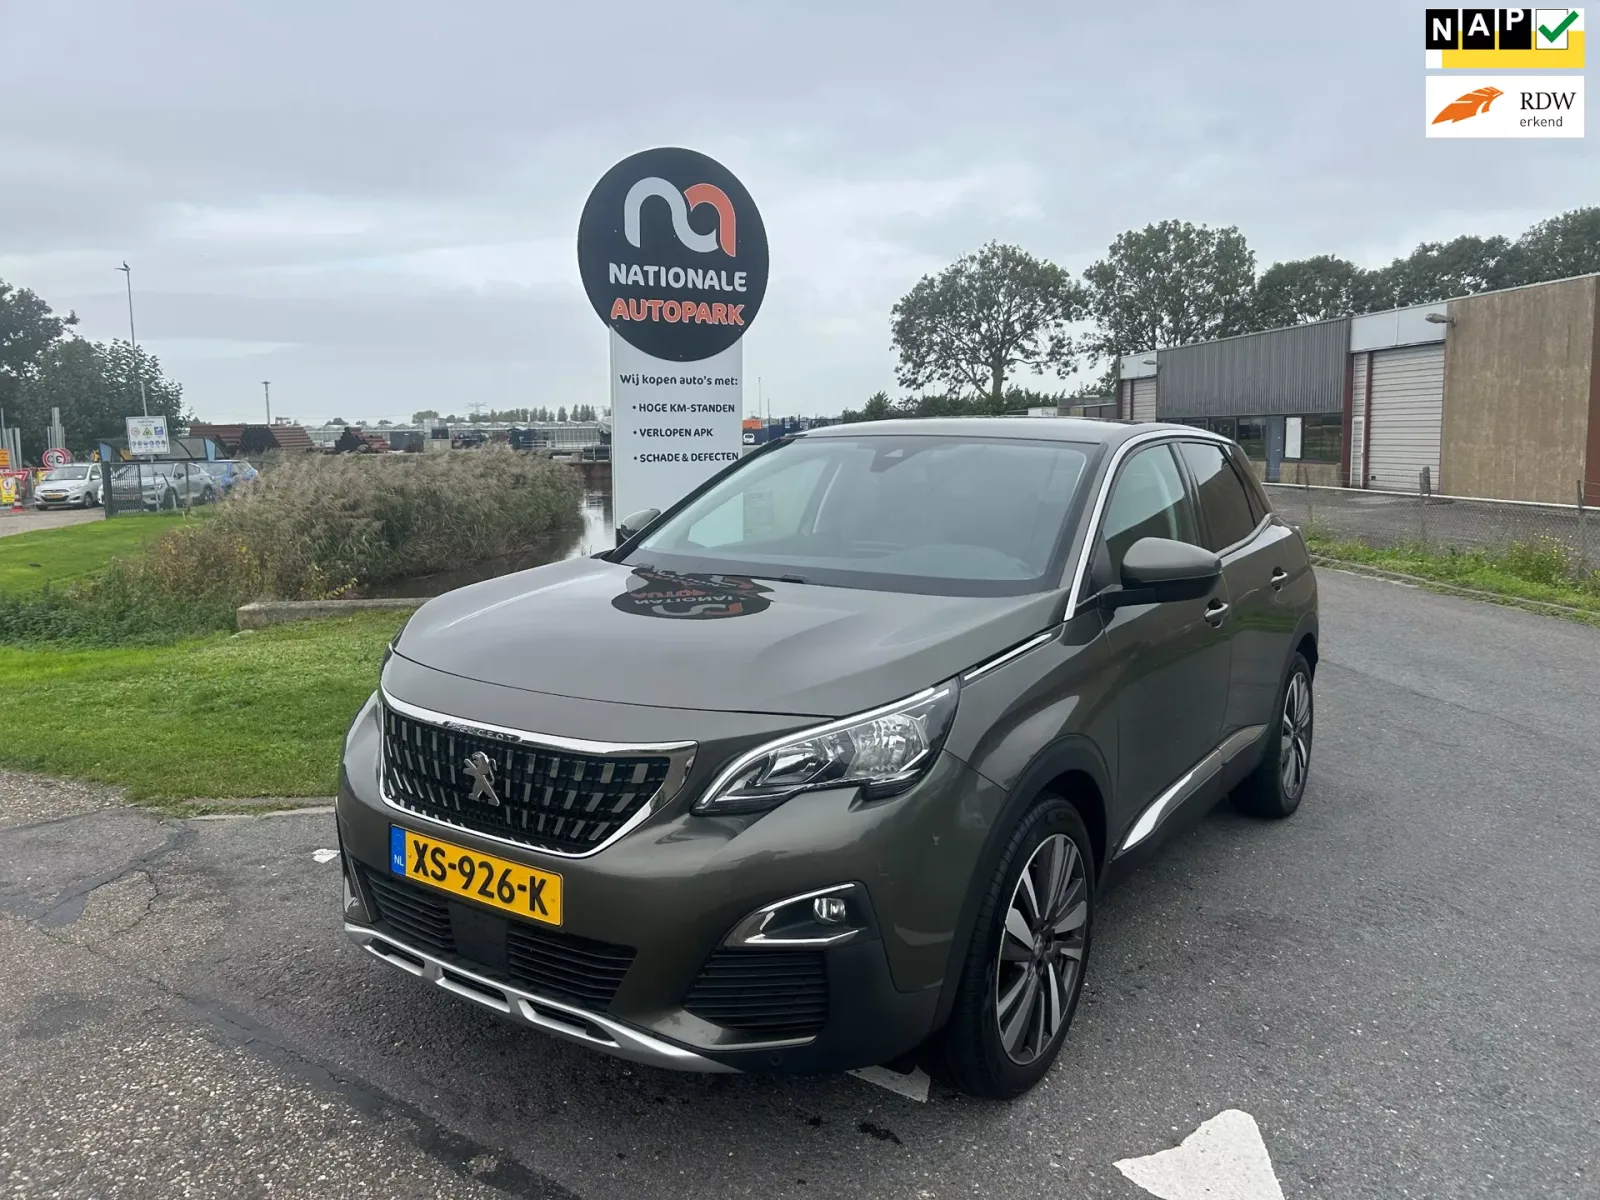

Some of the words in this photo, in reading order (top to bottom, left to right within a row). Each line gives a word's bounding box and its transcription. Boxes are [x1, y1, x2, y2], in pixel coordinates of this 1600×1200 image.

[609, 262, 747, 292] NATIONALE
[610, 297, 744, 326] AUTOPARK
[620, 374, 640, 386] Wij
[641, 375, 677, 386] kopen
[679, 376, 713, 386] auto's
[714, 377, 739, 386] met:
[639, 403, 668, 413] HOGE
[669, 403, 735, 413] KM-STANDEN
[639, 428, 692, 437] VERLOPEN
[693, 428, 714, 437] APK
[639, 453, 681, 463] SCHADE
[681, 454, 689, 462] &
[690, 452, 739, 462] DEFECTEN
[393, 854, 404, 867] NL
[413, 839, 549, 916] XS-926-K
